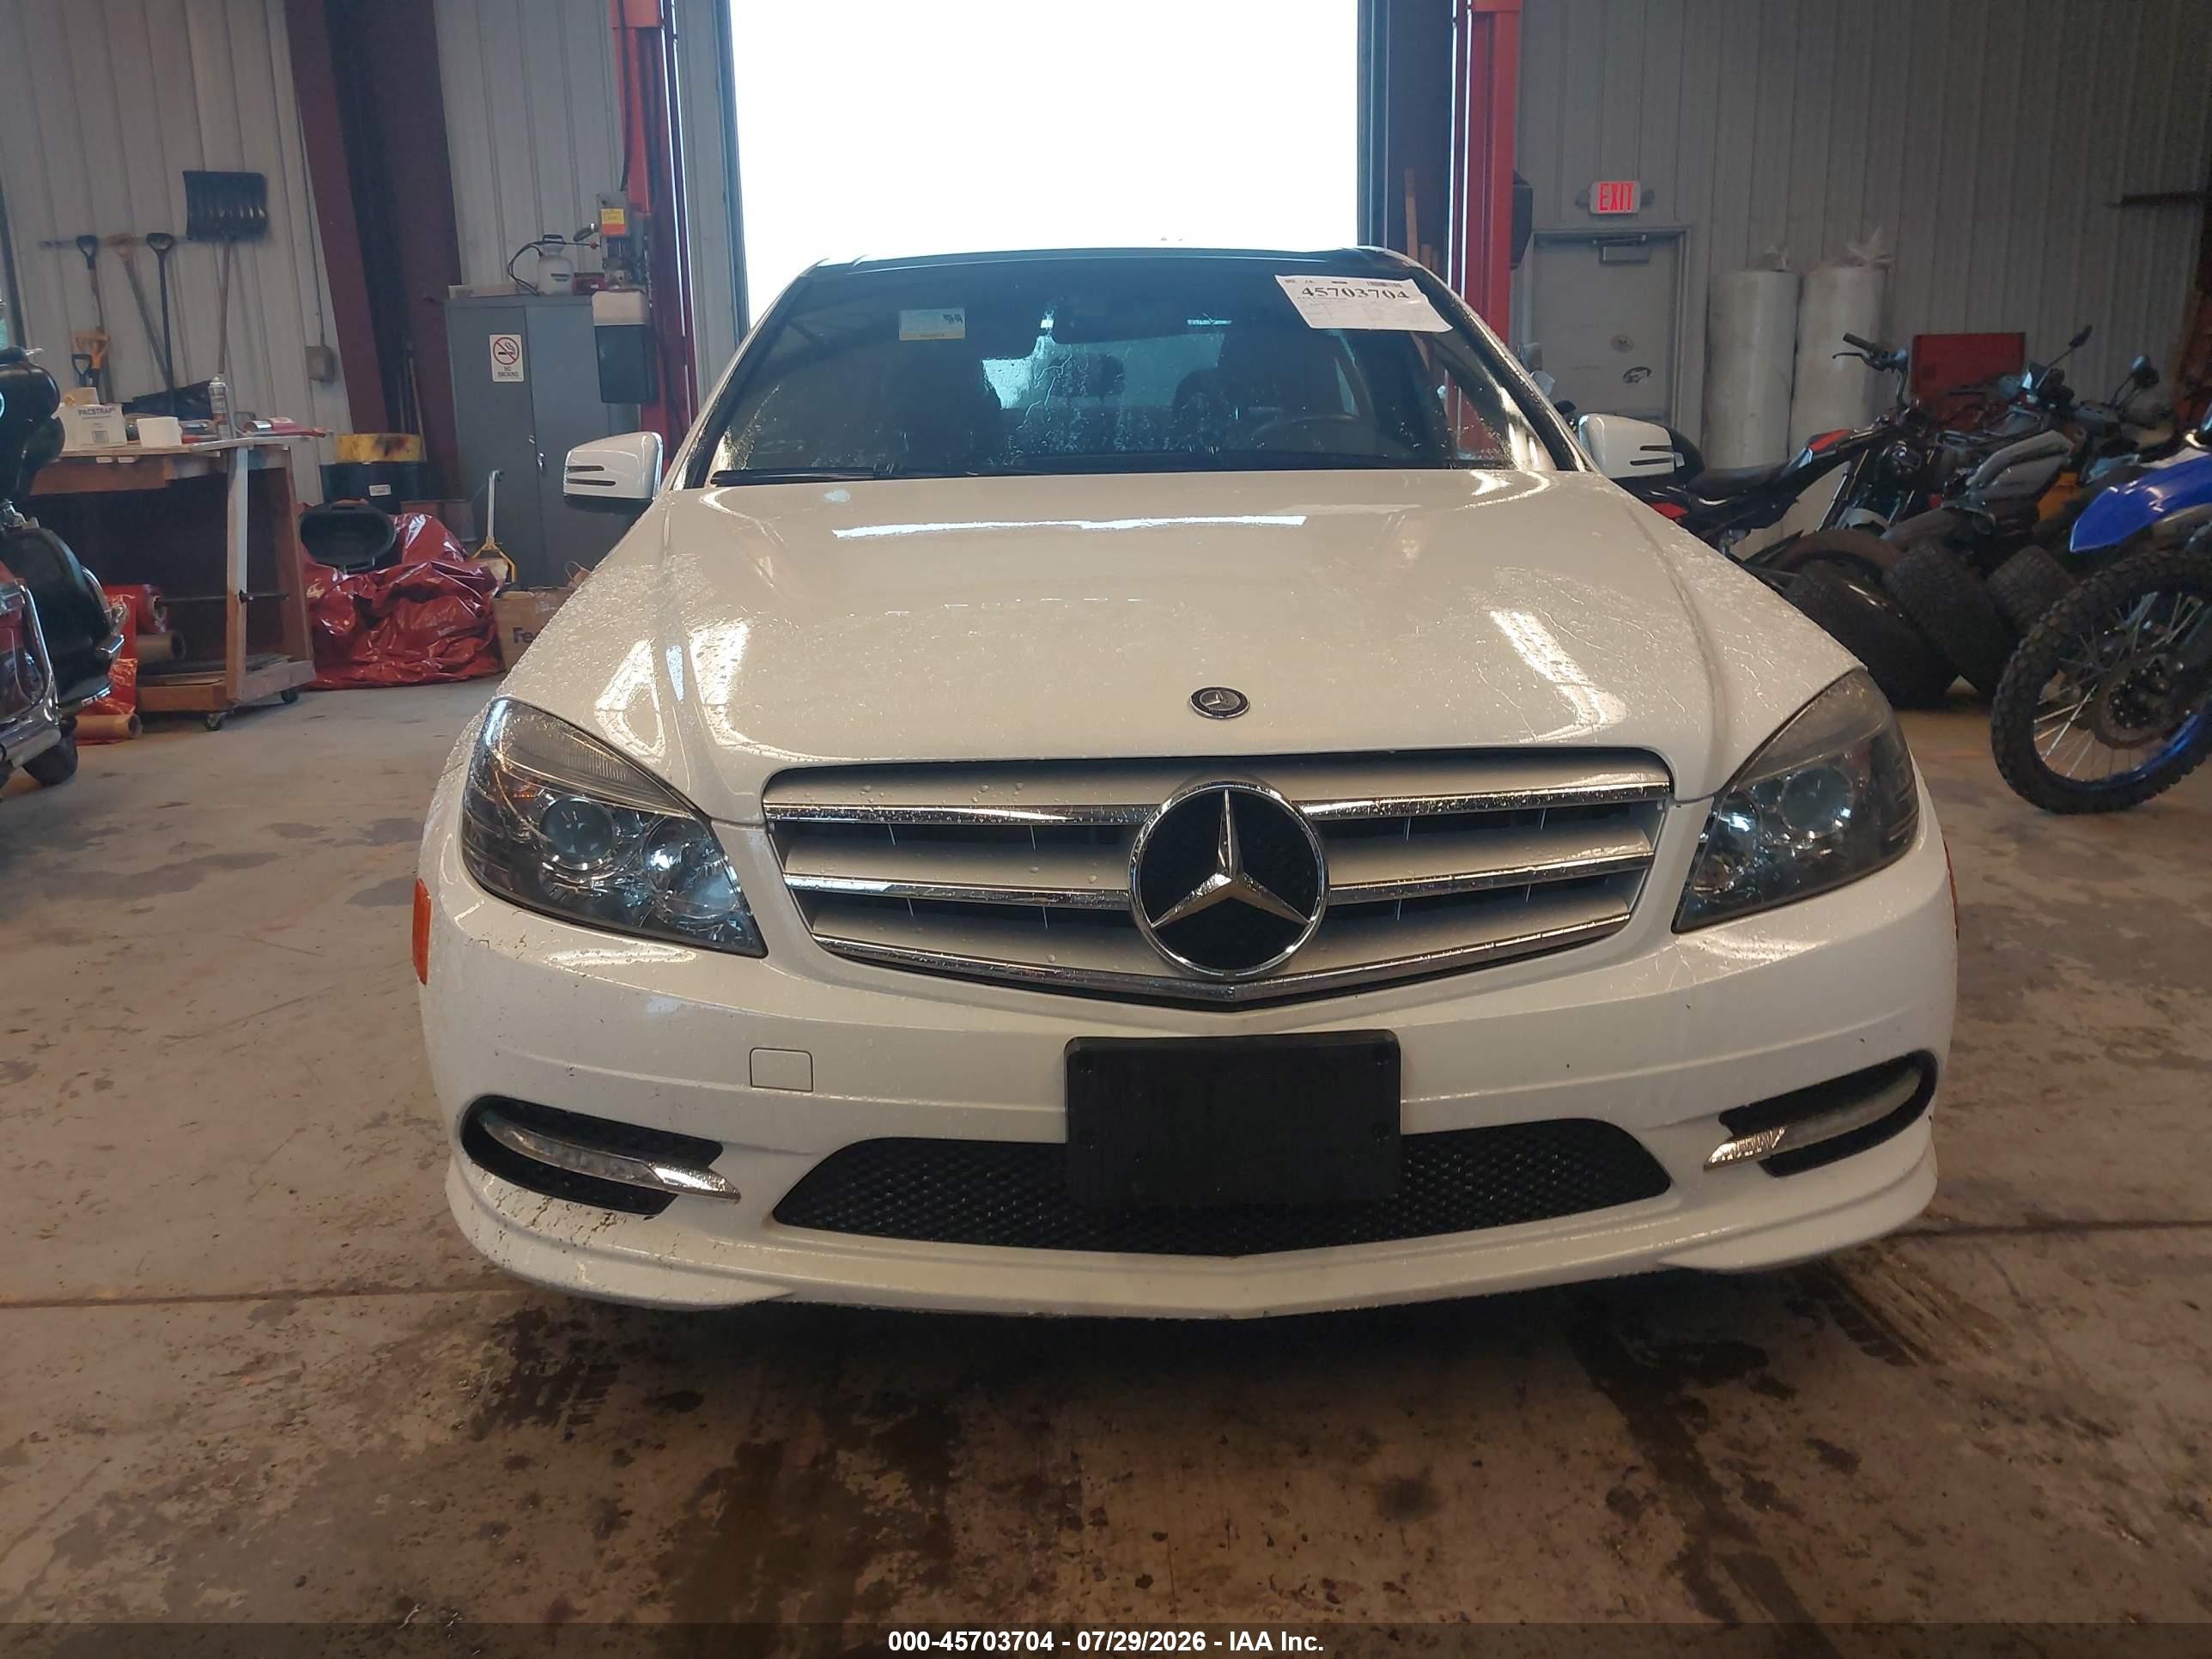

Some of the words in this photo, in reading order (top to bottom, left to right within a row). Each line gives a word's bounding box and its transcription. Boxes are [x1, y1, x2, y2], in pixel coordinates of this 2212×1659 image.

[1599, 182, 1635, 212] EXIT
[1301, 287, 1410, 300] 45703704
[513, 627, 536, 644] Fe
